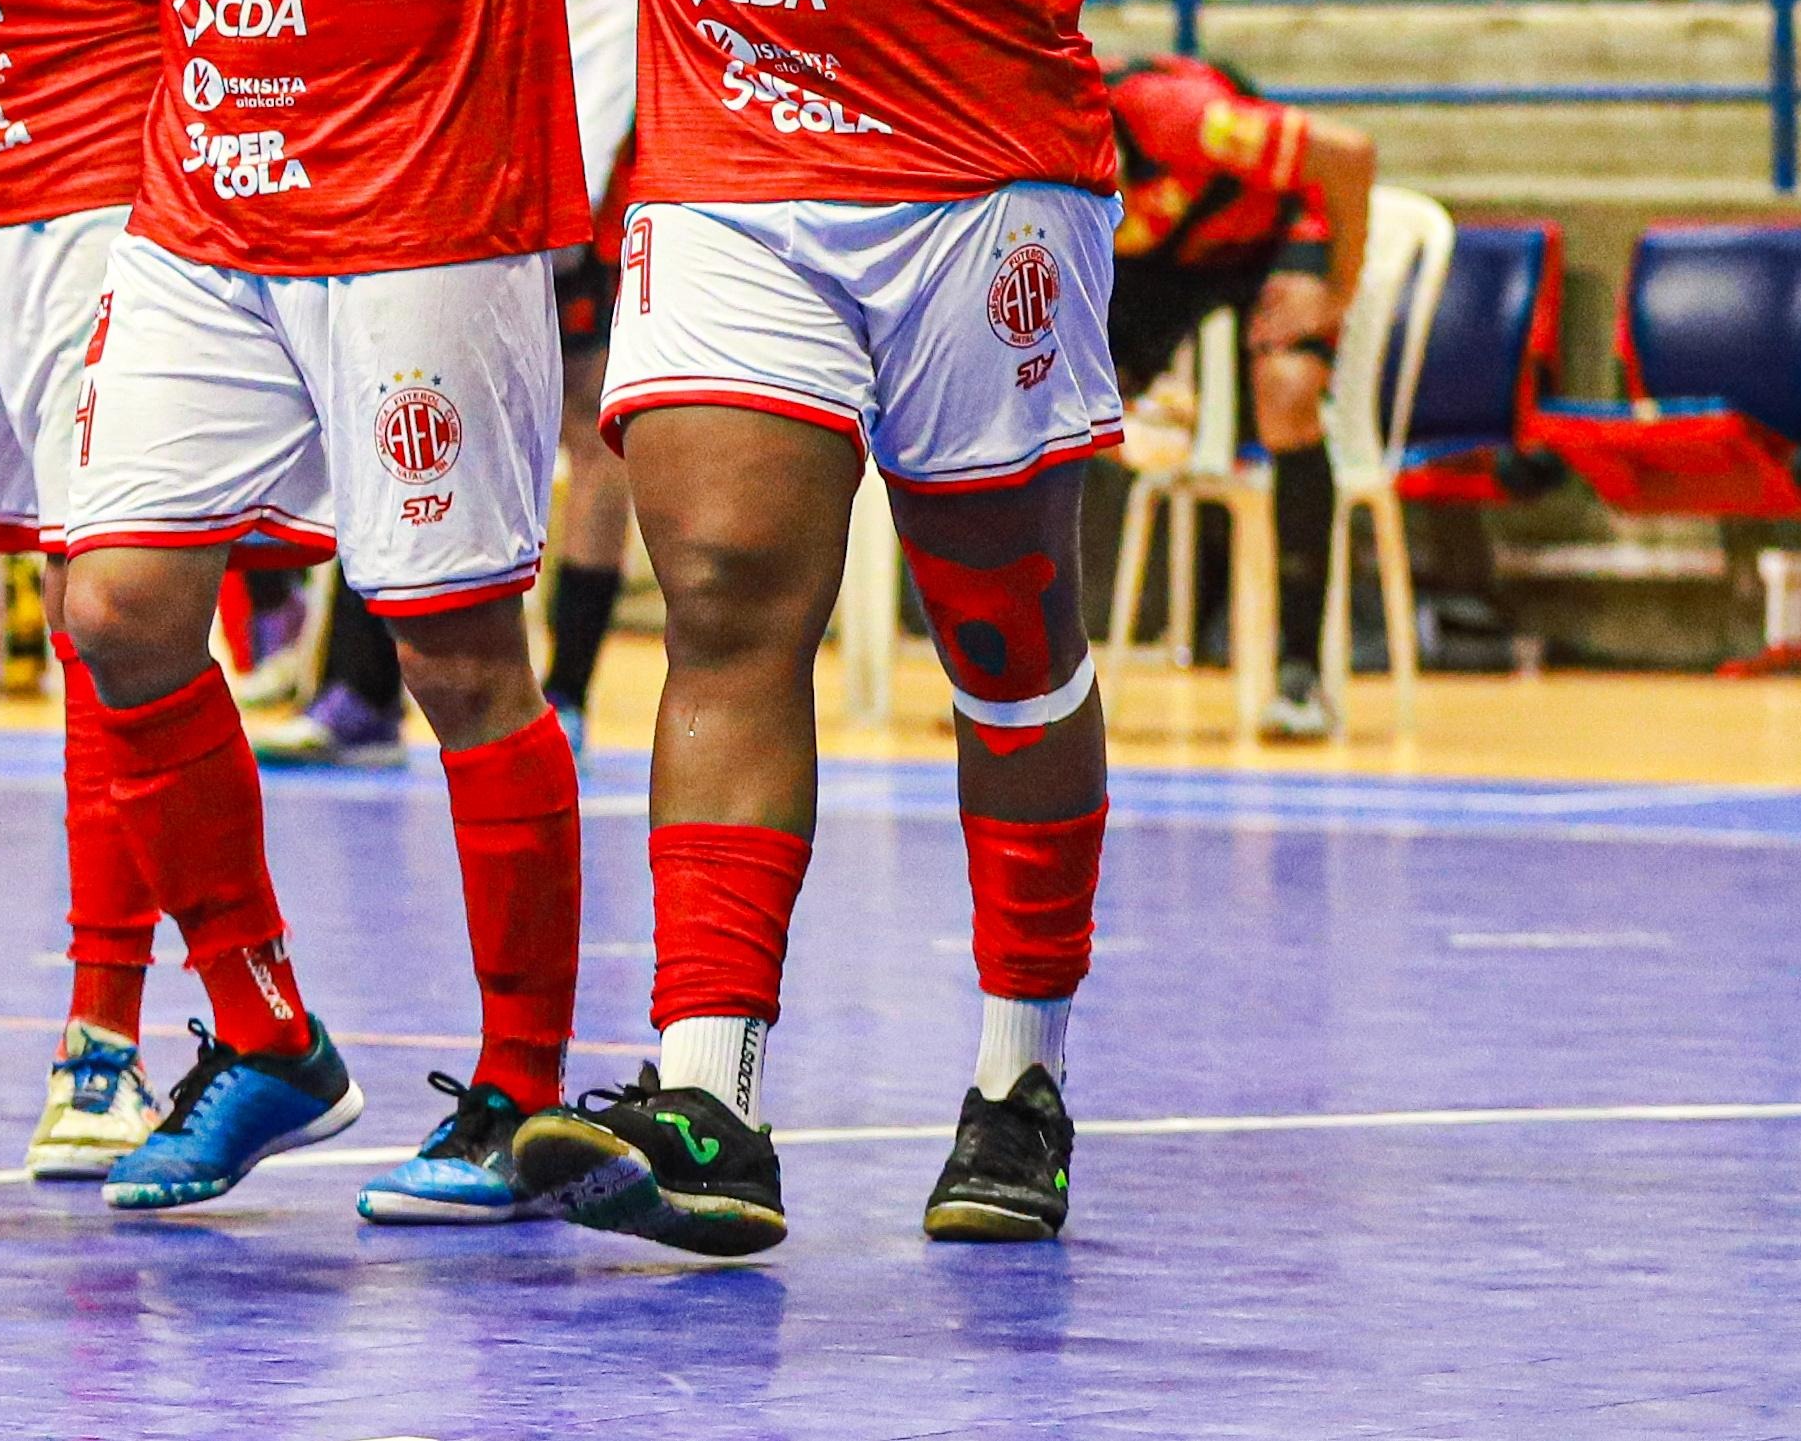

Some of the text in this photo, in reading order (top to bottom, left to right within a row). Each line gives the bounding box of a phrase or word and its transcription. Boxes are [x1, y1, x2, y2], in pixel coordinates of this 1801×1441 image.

[182, 122, 286, 174] SUPER
[213, 158, 312, 201] COLA
[1002, 262, 1050, 334] AFC
[386, 403, 449, 469] AFC
[400, 490, 454, 520] STY
